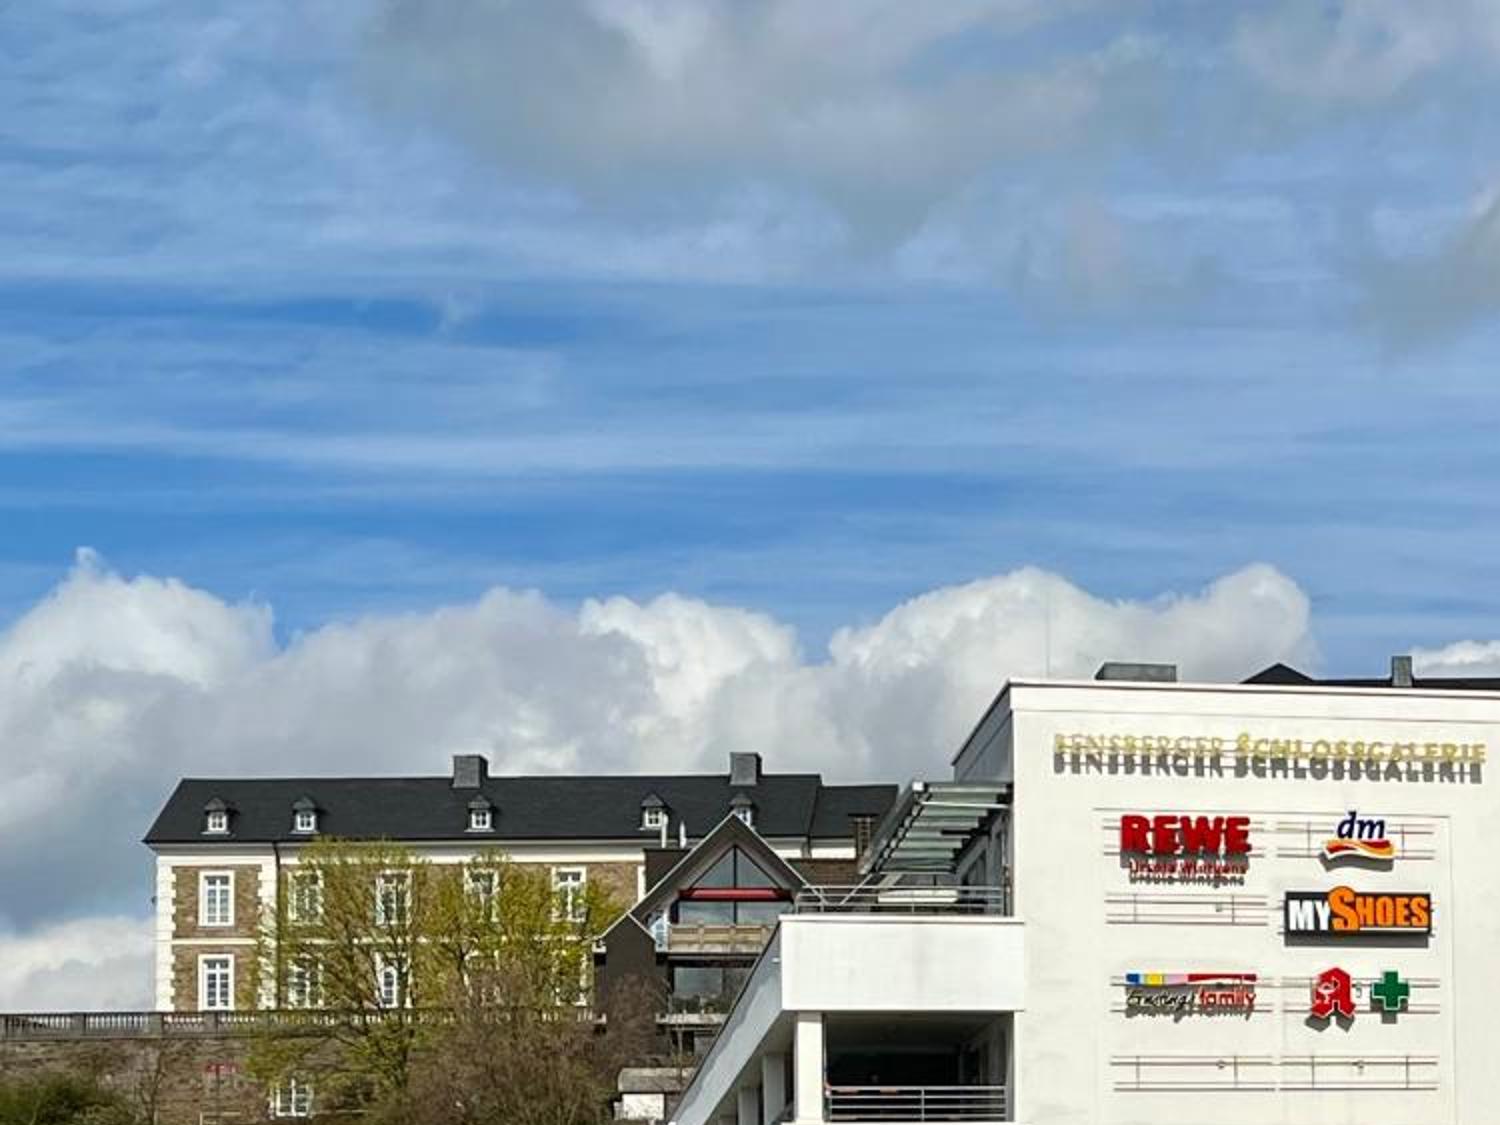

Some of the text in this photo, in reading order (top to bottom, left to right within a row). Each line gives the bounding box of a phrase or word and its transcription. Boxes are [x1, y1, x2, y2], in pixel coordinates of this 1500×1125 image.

[1235, 731, 1487, 763] SCHLOSSGALERIE
[1120, 815, 1252, 854] REWE
[1337, 811, 1385, 839] dm
